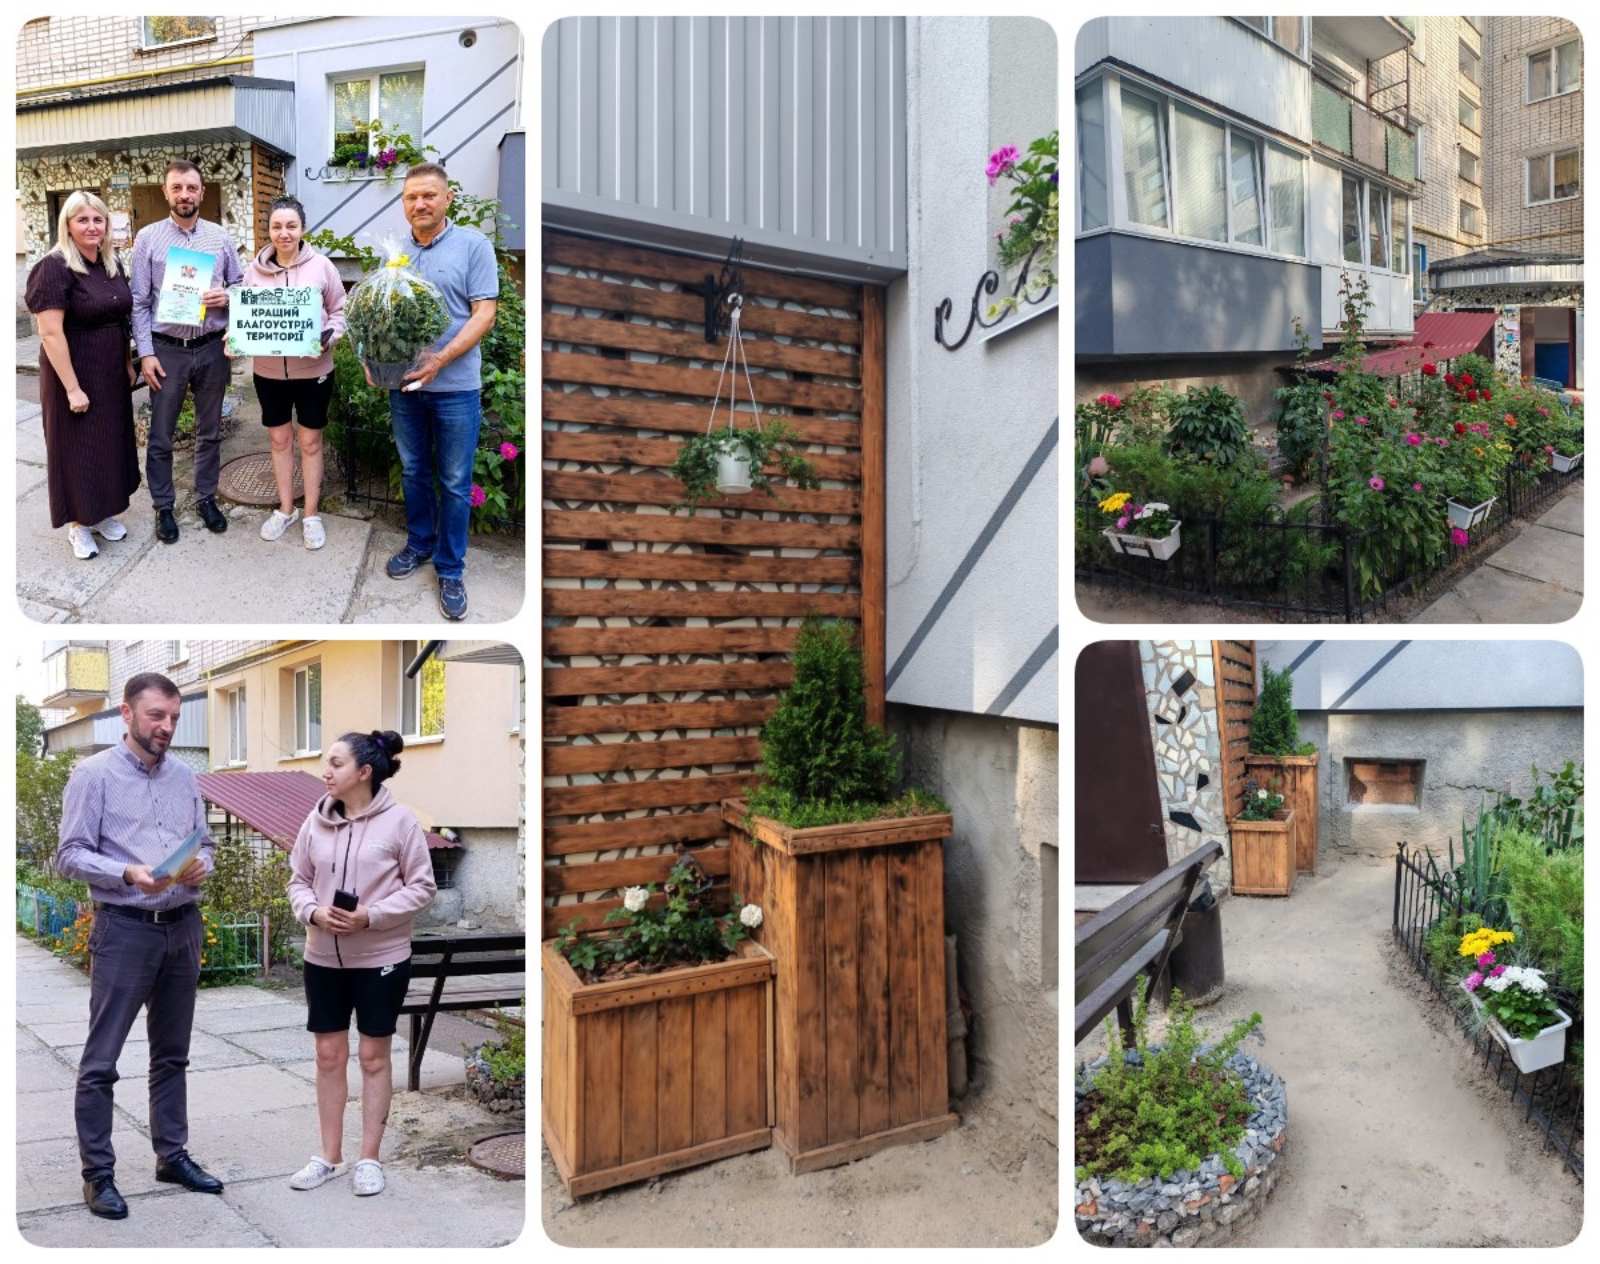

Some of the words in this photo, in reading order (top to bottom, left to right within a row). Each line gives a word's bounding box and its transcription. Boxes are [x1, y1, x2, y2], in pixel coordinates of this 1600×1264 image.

[251, 306, 300, 318] КРАЩИЙ
[236, 318, 314, 330] БЛАГОУСТРІЙ
[246, 330, 304, 341] ТЕРИТОРІЇ
